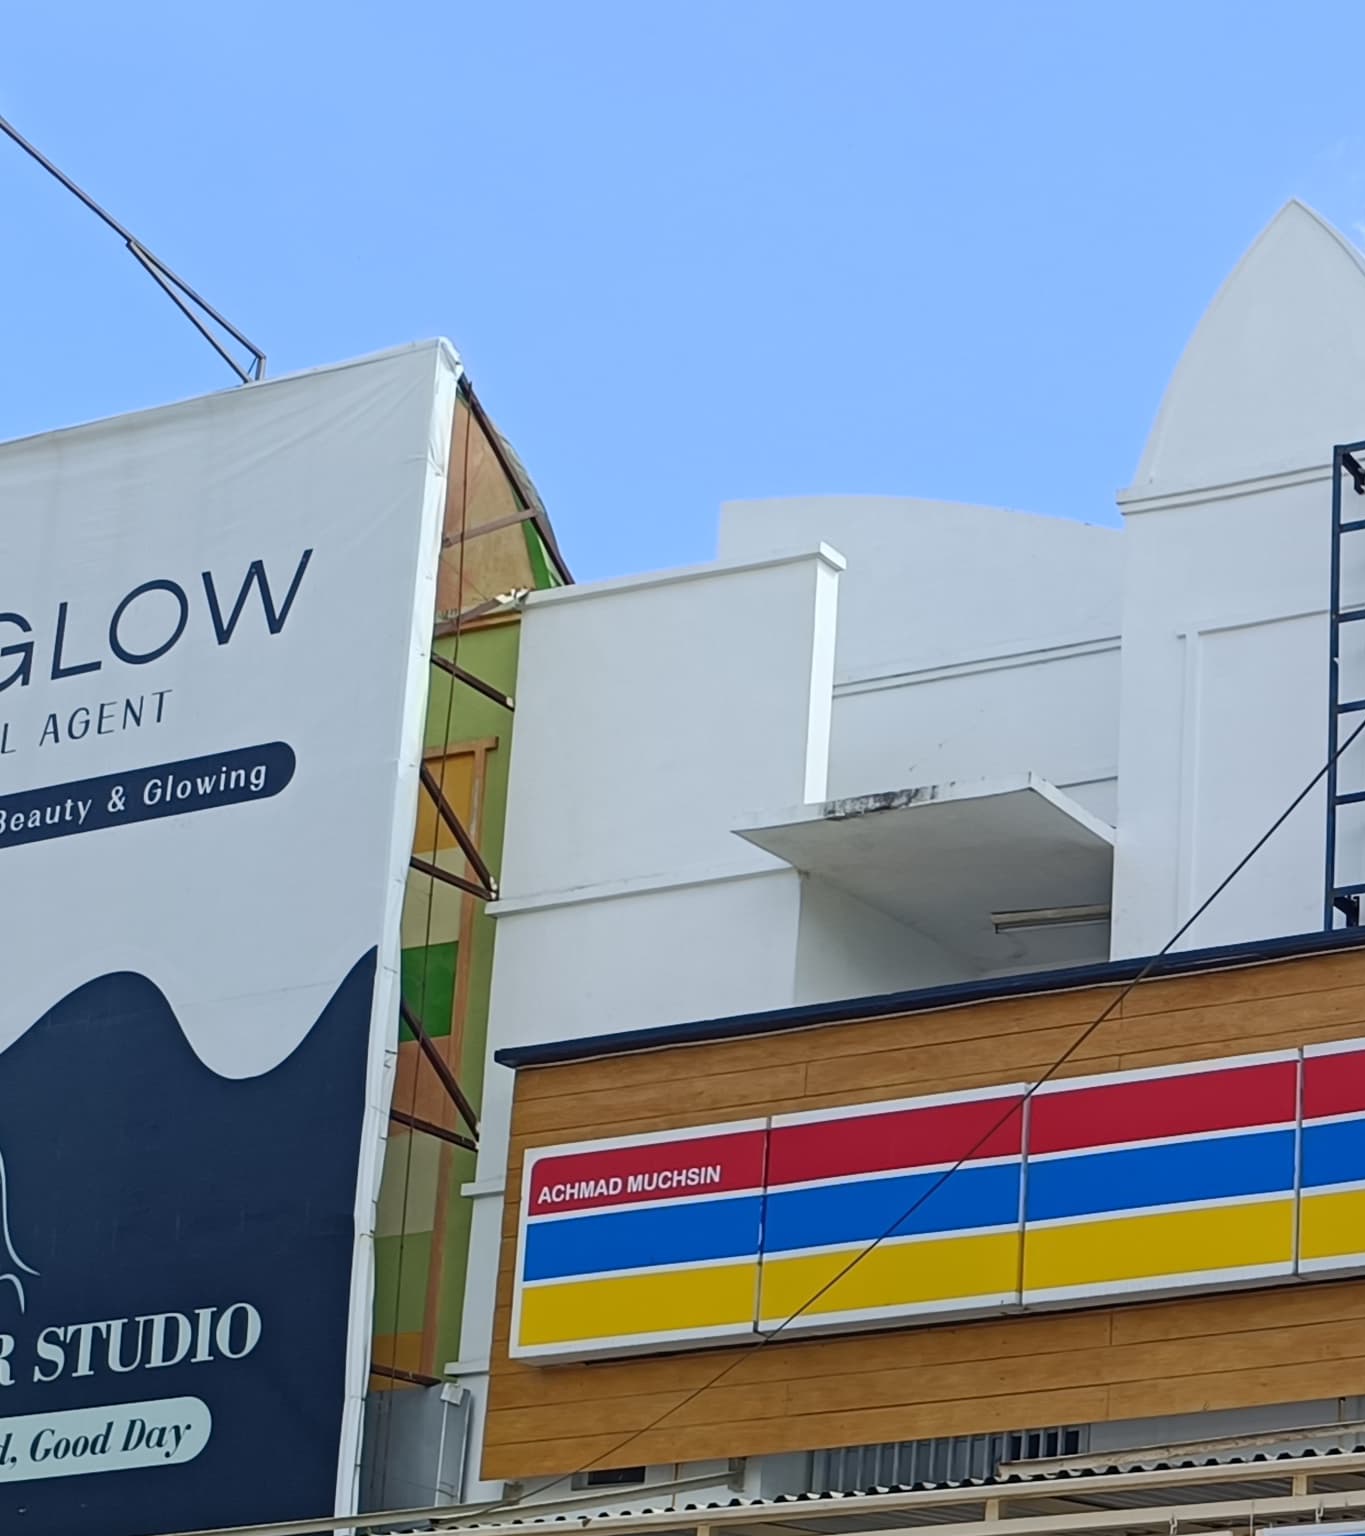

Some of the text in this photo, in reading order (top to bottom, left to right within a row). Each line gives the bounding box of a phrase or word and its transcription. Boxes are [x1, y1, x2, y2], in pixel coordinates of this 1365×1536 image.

[39, 688, 173, 747] AGENT
[106, 785, 127, 814] &
[142, 759, 267, 806] Glowing
[538, 1165, 721, 1205] ACHMAD MUCHSIN
[33, 1302, 262, 1383] STUDIO
[30, 1419, 114, 1464] Good
[121, 1417, 191, 1459] Day
